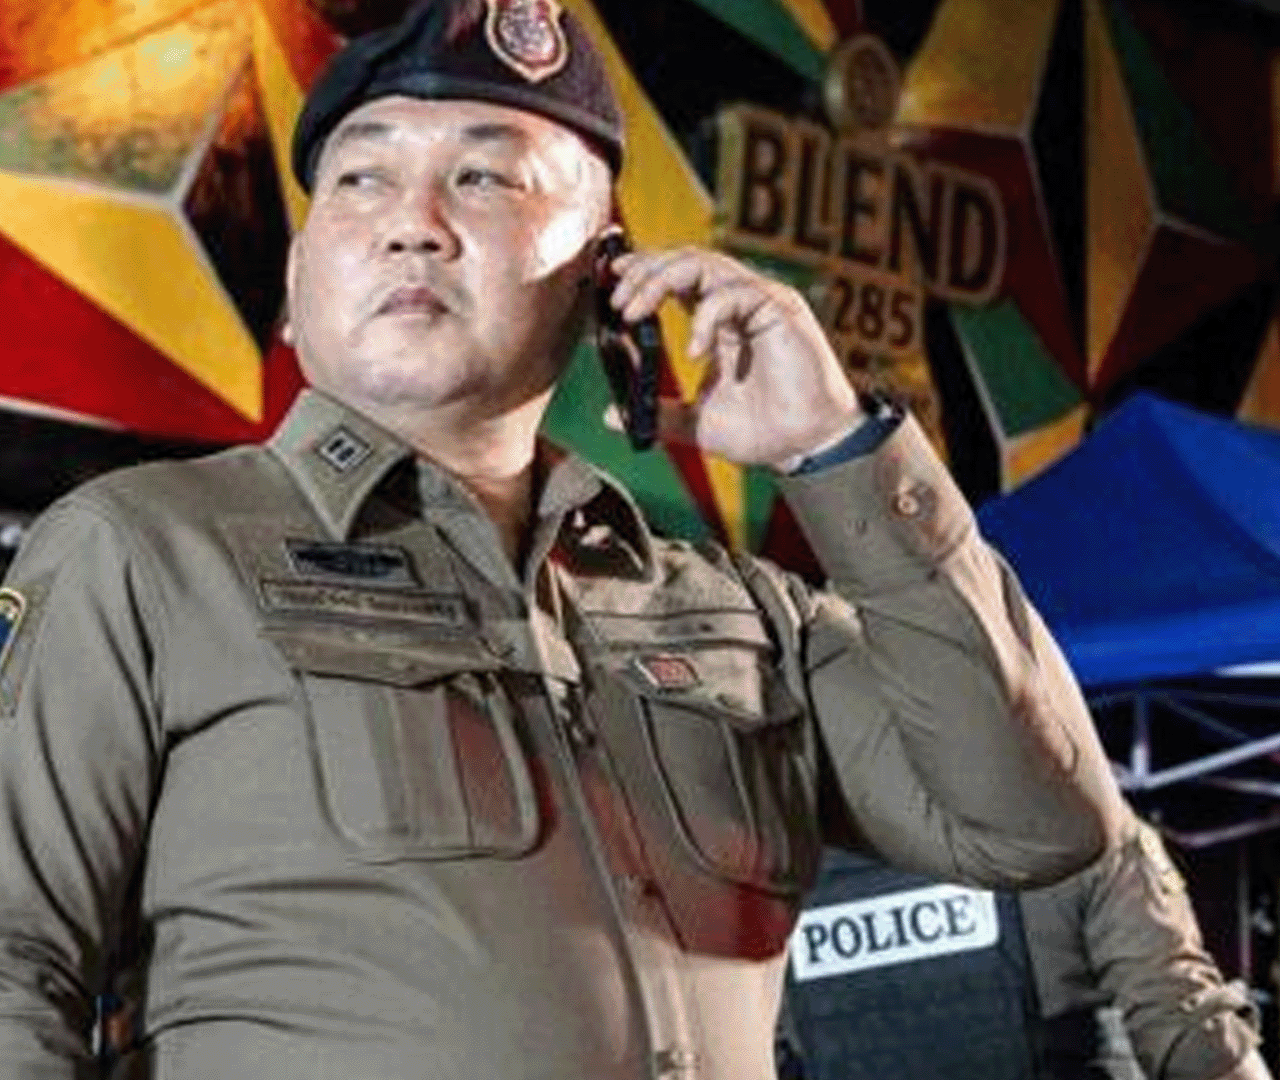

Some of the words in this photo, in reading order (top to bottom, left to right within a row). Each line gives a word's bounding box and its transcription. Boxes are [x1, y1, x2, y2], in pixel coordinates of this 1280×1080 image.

[739, 122, 1004, 295] BLEND
[832, 276, 915, 350] 285
[802, 894, 977, 964] POLICE
